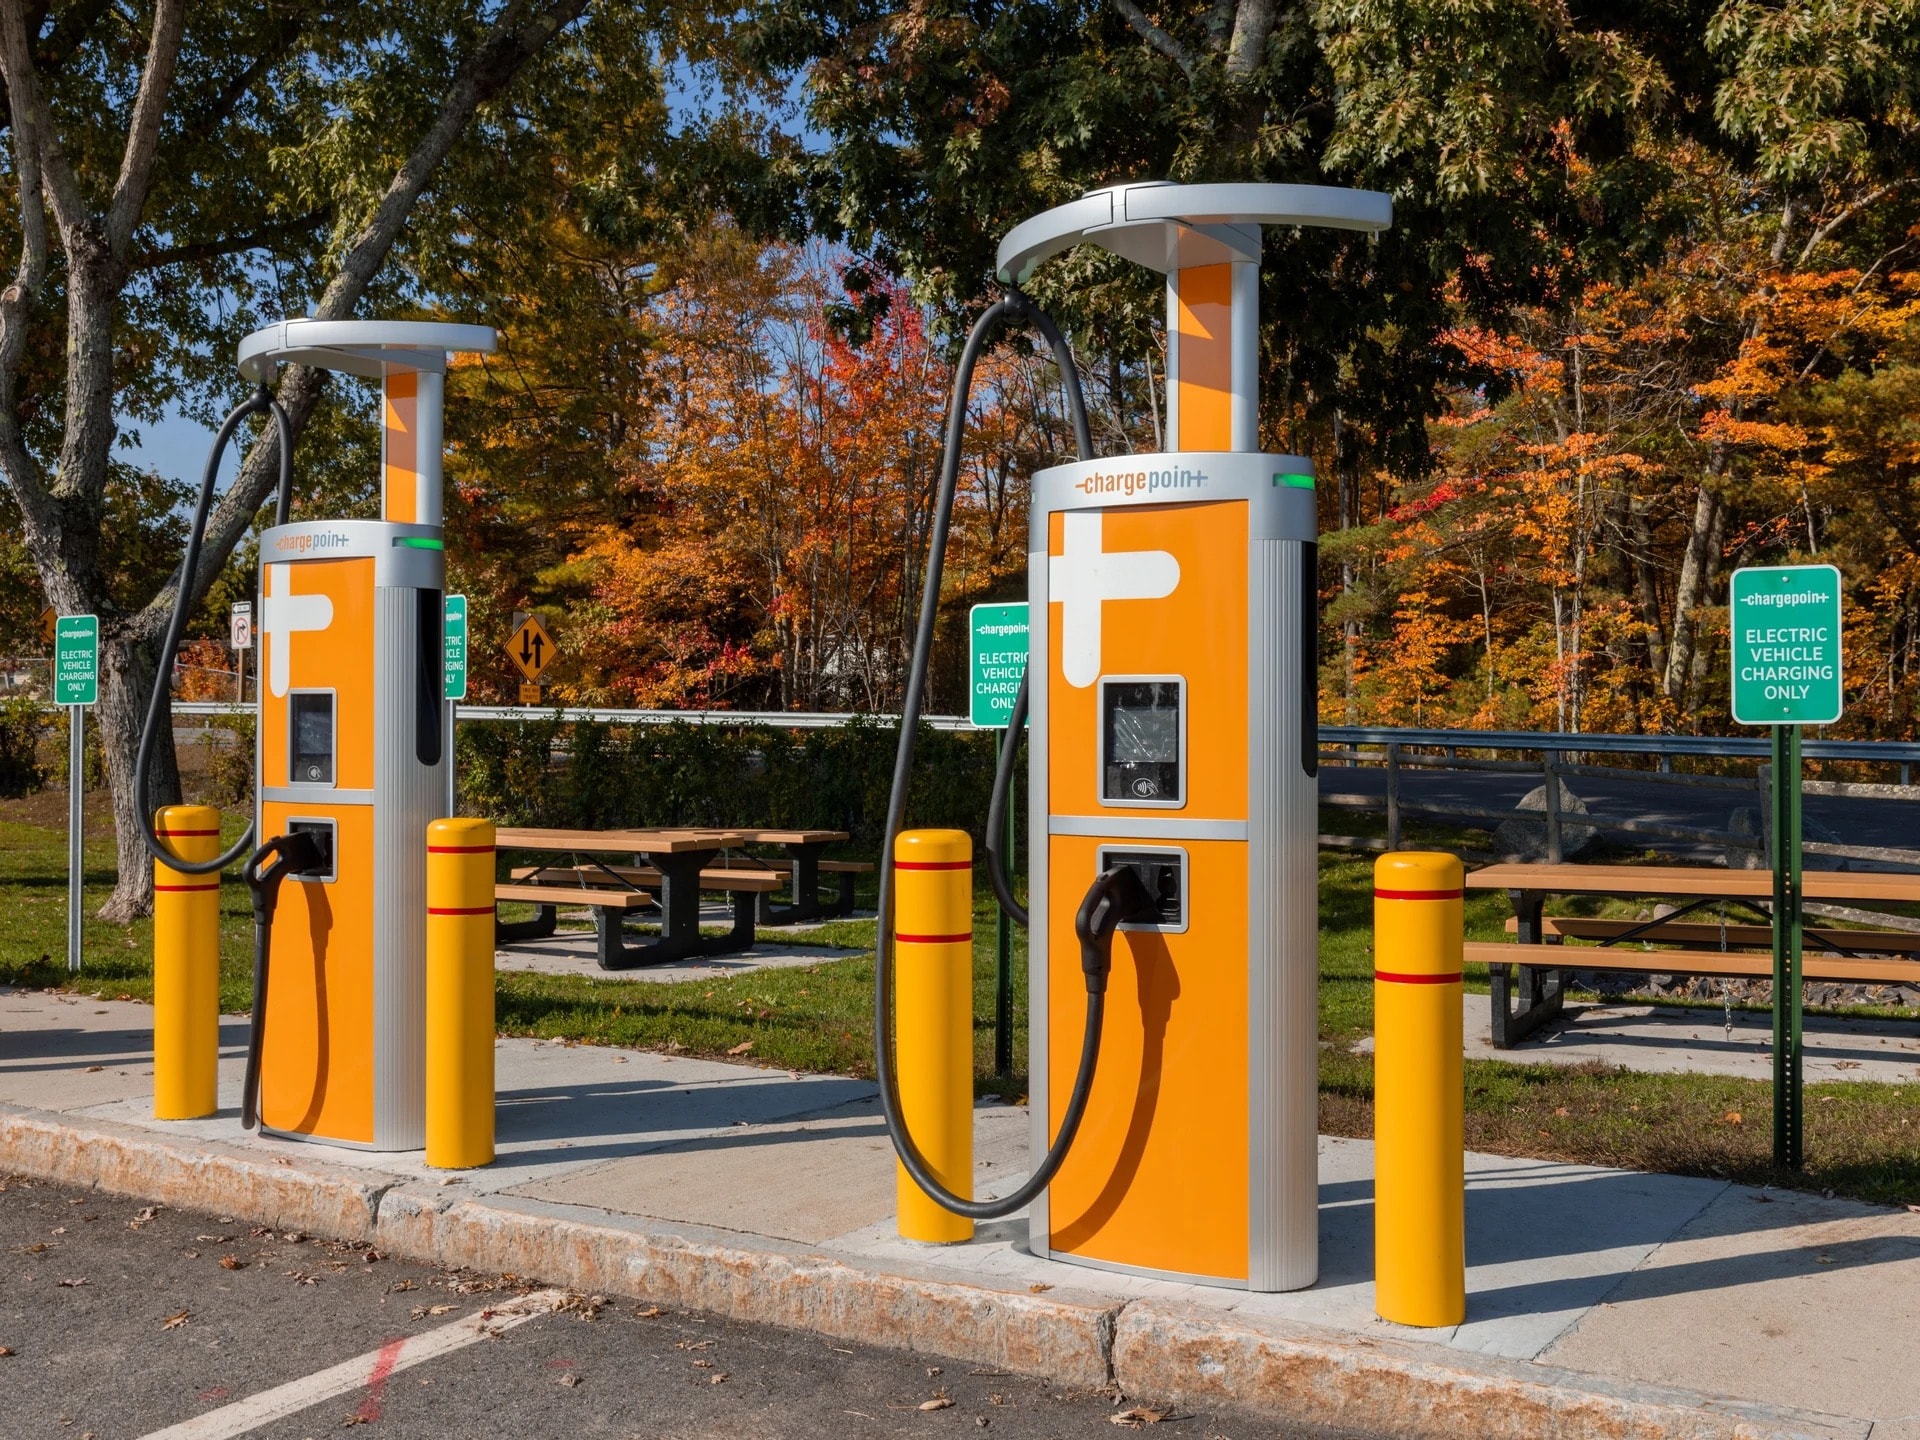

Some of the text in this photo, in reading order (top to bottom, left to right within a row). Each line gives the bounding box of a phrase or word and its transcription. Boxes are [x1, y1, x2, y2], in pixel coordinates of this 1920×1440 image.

[1746, 627, 1828, 644] ELECTRIC
[61, 649, 93, 660] ELECTRIC
[1750, 646, 1823, 662] VEHICLE
[62, 660, 91, 670] VEHICLE
[58, 671, 95, 681] CHARGING
[1741, 665, 1833, 681] CHARGING
[67, 682, 86, 692] ONLY
[976, 682, 1021, 694] CHARGI
[1764, 685, 1810, 700] ONLY
